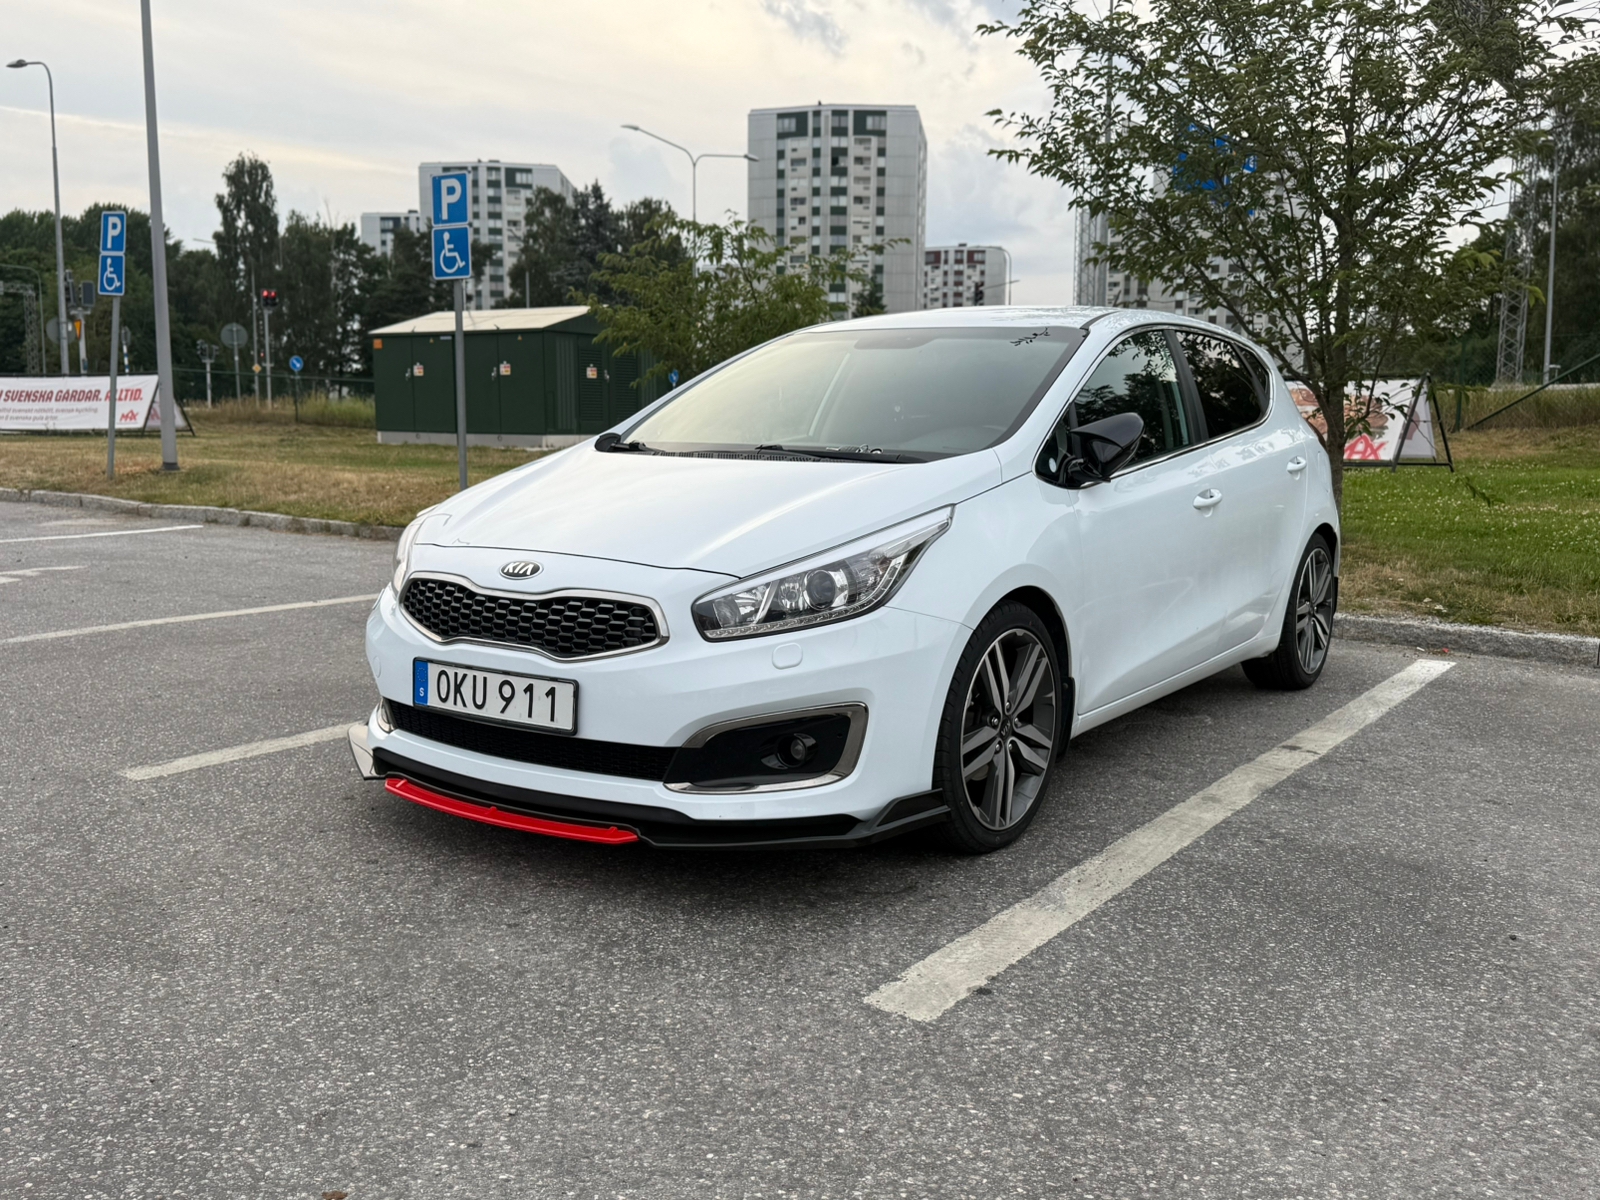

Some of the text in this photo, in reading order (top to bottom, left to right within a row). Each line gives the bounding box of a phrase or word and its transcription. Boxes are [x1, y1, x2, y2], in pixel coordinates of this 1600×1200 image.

[441, 178, 462, 220] P
[107, 216, 122, 249] P
[1344, 433, 1389, 460] AX
[503, 562, 534, 576] KIA
[419, 687, 425, 697] S
[436, 669, 557, 722] OKU 911
